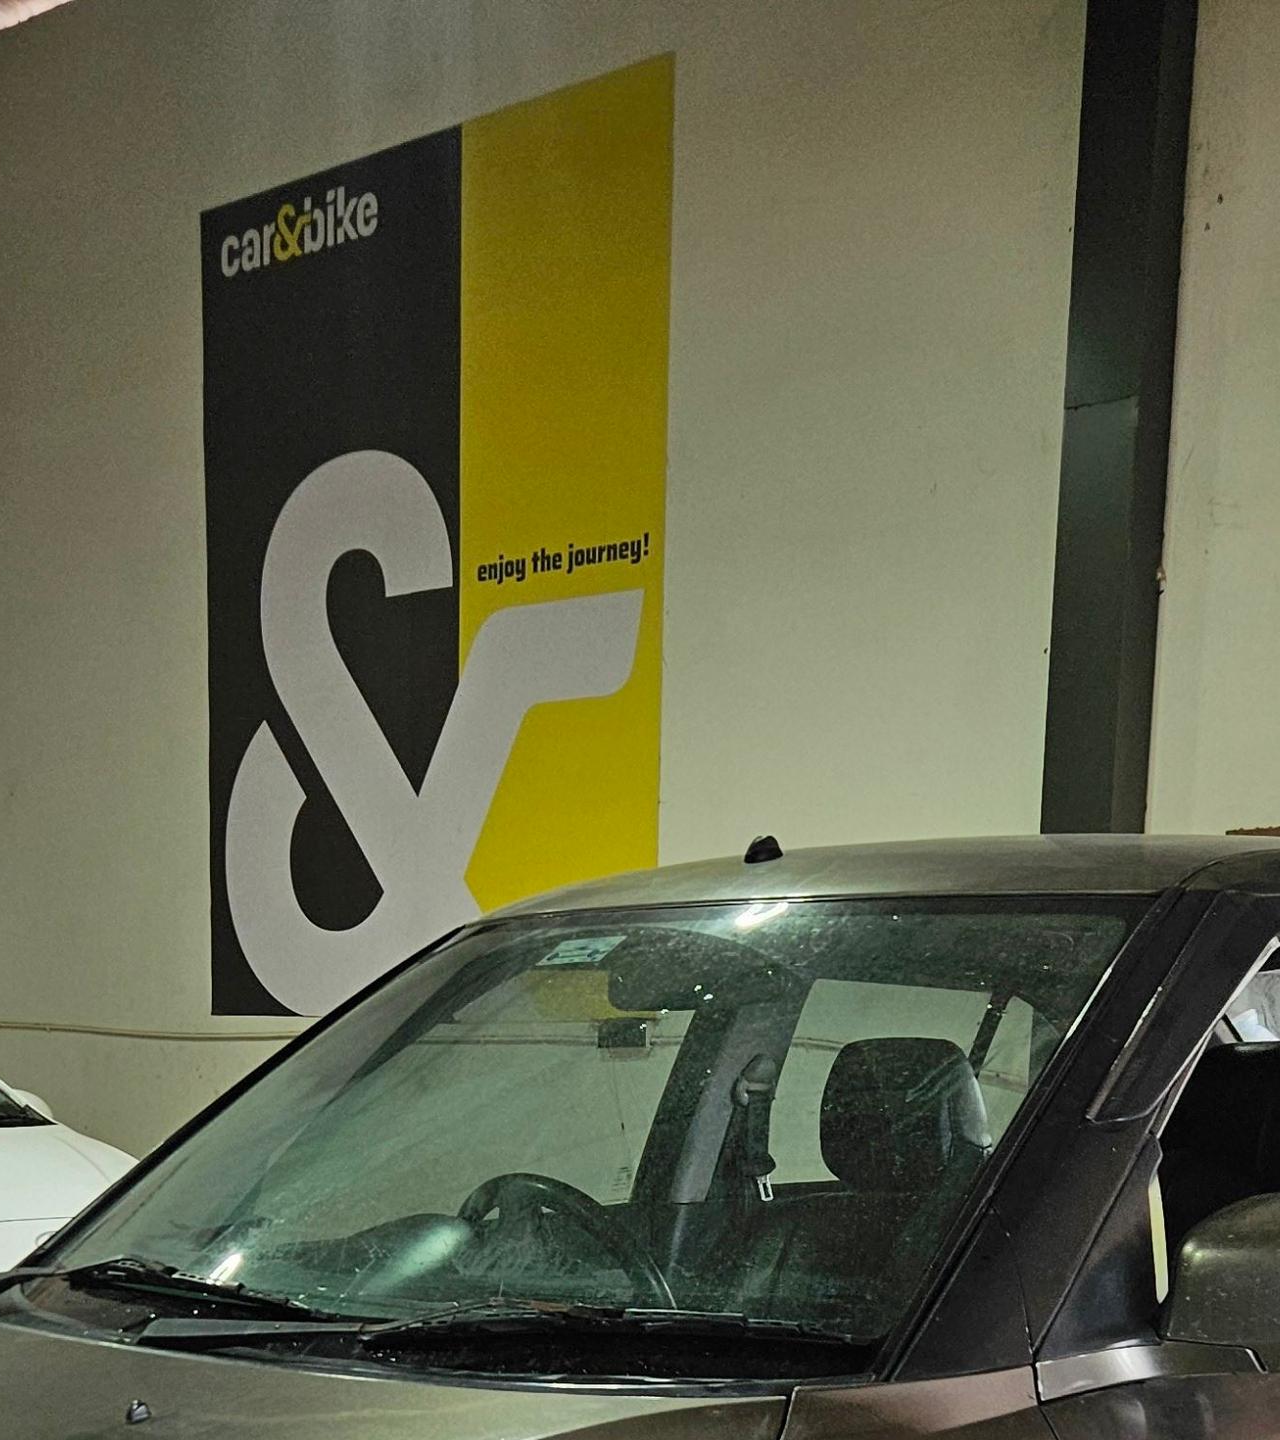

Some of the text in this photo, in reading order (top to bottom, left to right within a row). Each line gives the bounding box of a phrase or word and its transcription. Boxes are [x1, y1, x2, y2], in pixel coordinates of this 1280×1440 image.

[221, 186, 379, 277] car&bike
[477, 532, 650, 585] enjoy the journey!
